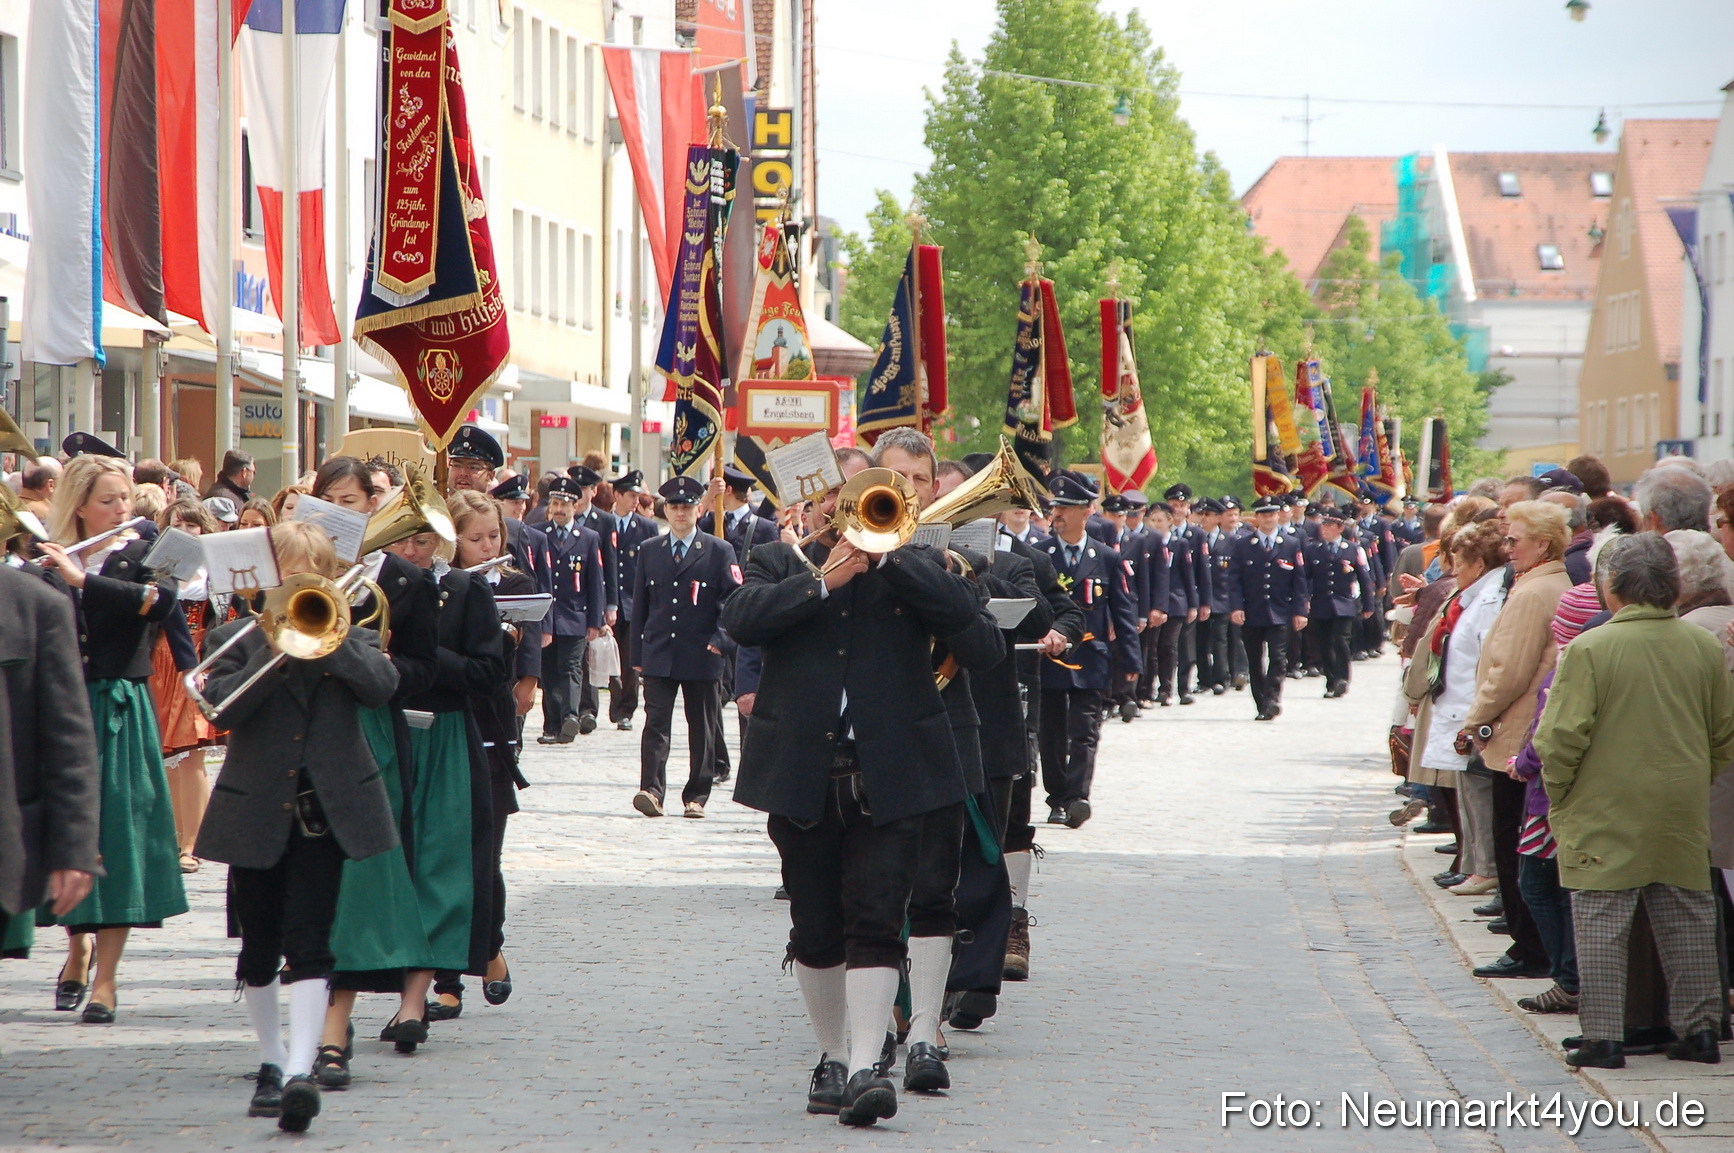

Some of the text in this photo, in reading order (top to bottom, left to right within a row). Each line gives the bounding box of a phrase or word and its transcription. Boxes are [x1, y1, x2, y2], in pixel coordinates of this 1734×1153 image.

[395, 47, 437, 63] Gewidmet
[400, 67, 431, 78] von den
[396, 114, 432, 154] Festdamen
[403, 185, 419, 195] zum
[403, 230, 417, 249] fest
[430, 315, 456, 336] und
[764, 408, 815, 421] Engelsberg
